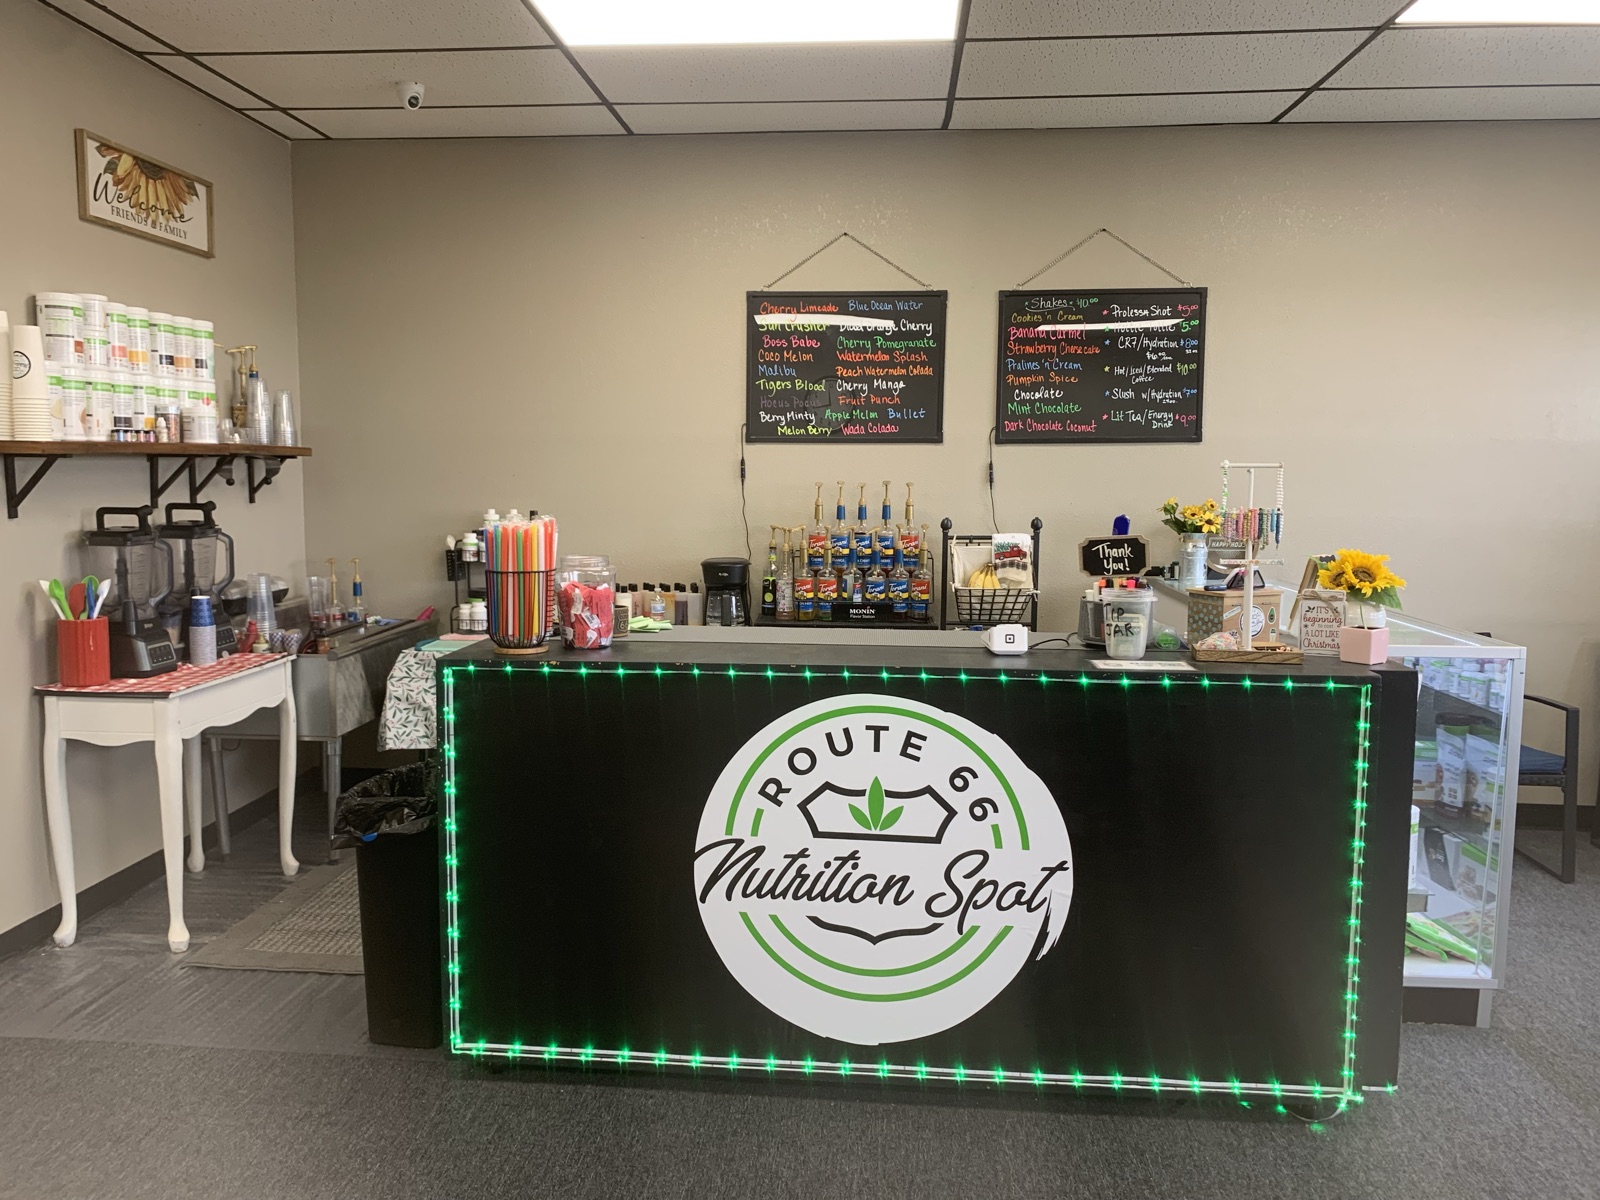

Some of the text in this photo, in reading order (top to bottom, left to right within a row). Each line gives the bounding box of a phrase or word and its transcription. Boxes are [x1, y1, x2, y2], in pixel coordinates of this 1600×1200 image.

[93, 172, 193, 224] Welcome
[111, 205, 148, 227] FRIENDS
[159, 222, 188, 240] FAMILY
[848, 299, 923, 311] Blue Ocean Water
[1031, 297, 1068, 309] Shakes
[760, 301, 839, 322] Cherry Limeade
[1011, 312, 1043, 323] Cookies
[1057, 310, 1084, 321] Cream
[1150, 305, 1172, 317] Shot
[900, 319, 933, 336] Cherry
[1008, 326, 1047, 340] Banana
[762, 335, 820, 348] Boss Babe
[837, 335, 936, 354] Cherry Pomegranate
[758, 349, 814, 362] Coco Melon
[836, 350, 928, 364] Watermelon Splash
[1007, 341, 1057, 361] Strawberry
[758, 364, 797, 377] Malibu
[835, 364, 934, 377] Peach Watermelon Colada
[1005, 358, 1040, 371] Pralines
[1052, 357, 1083, 371] Cream
[1006, 371, 1078, 387] Pumpkin Spice
[1131, 376, 1154, 385] Coffee
[755, 379, 826, 397] Tigers Blood
[836, 379, 868, 397] Cherry
[1014, 386, 1064, 400] Chocolate
[1111, 387, 1135, 399] Slush
[760, 396, 790, 408] Hocus
[838, 393, 901, 406] Fruit Punch
[1007, 401, 1082, 415] Mint Chocolate
[759, 408, 926, 426] Berry Minty Apple Melon Bullet
[1111, 410, 1124, 421] Lit
[777, 425, 806, 436] Melon
[806, 425, 832, 437] Berry
[868, 422, 899, 434] Colada
[1004, 418, 1097, 432] Dark Chocolate Coconut
[1152, 420, 1173, 429] Drink
[809, 538, 825, 549] Toran
[1091, 542, 1134, 559] Thank
[1103, 557, 1130, 576] You!
[1104, 603, 1125, 622] TIP
[1303, 613, 1343, 628] beginning
[1106, 622, 1134, 638] JAR
[1305, 630, 1340, 639] A LOT LIKE
[1303, 637, 1341, 649] Christmas
[758, 725, 1000, 821] ROUTE 66
[694, 838, 1069, 935] Nutrition Spot
